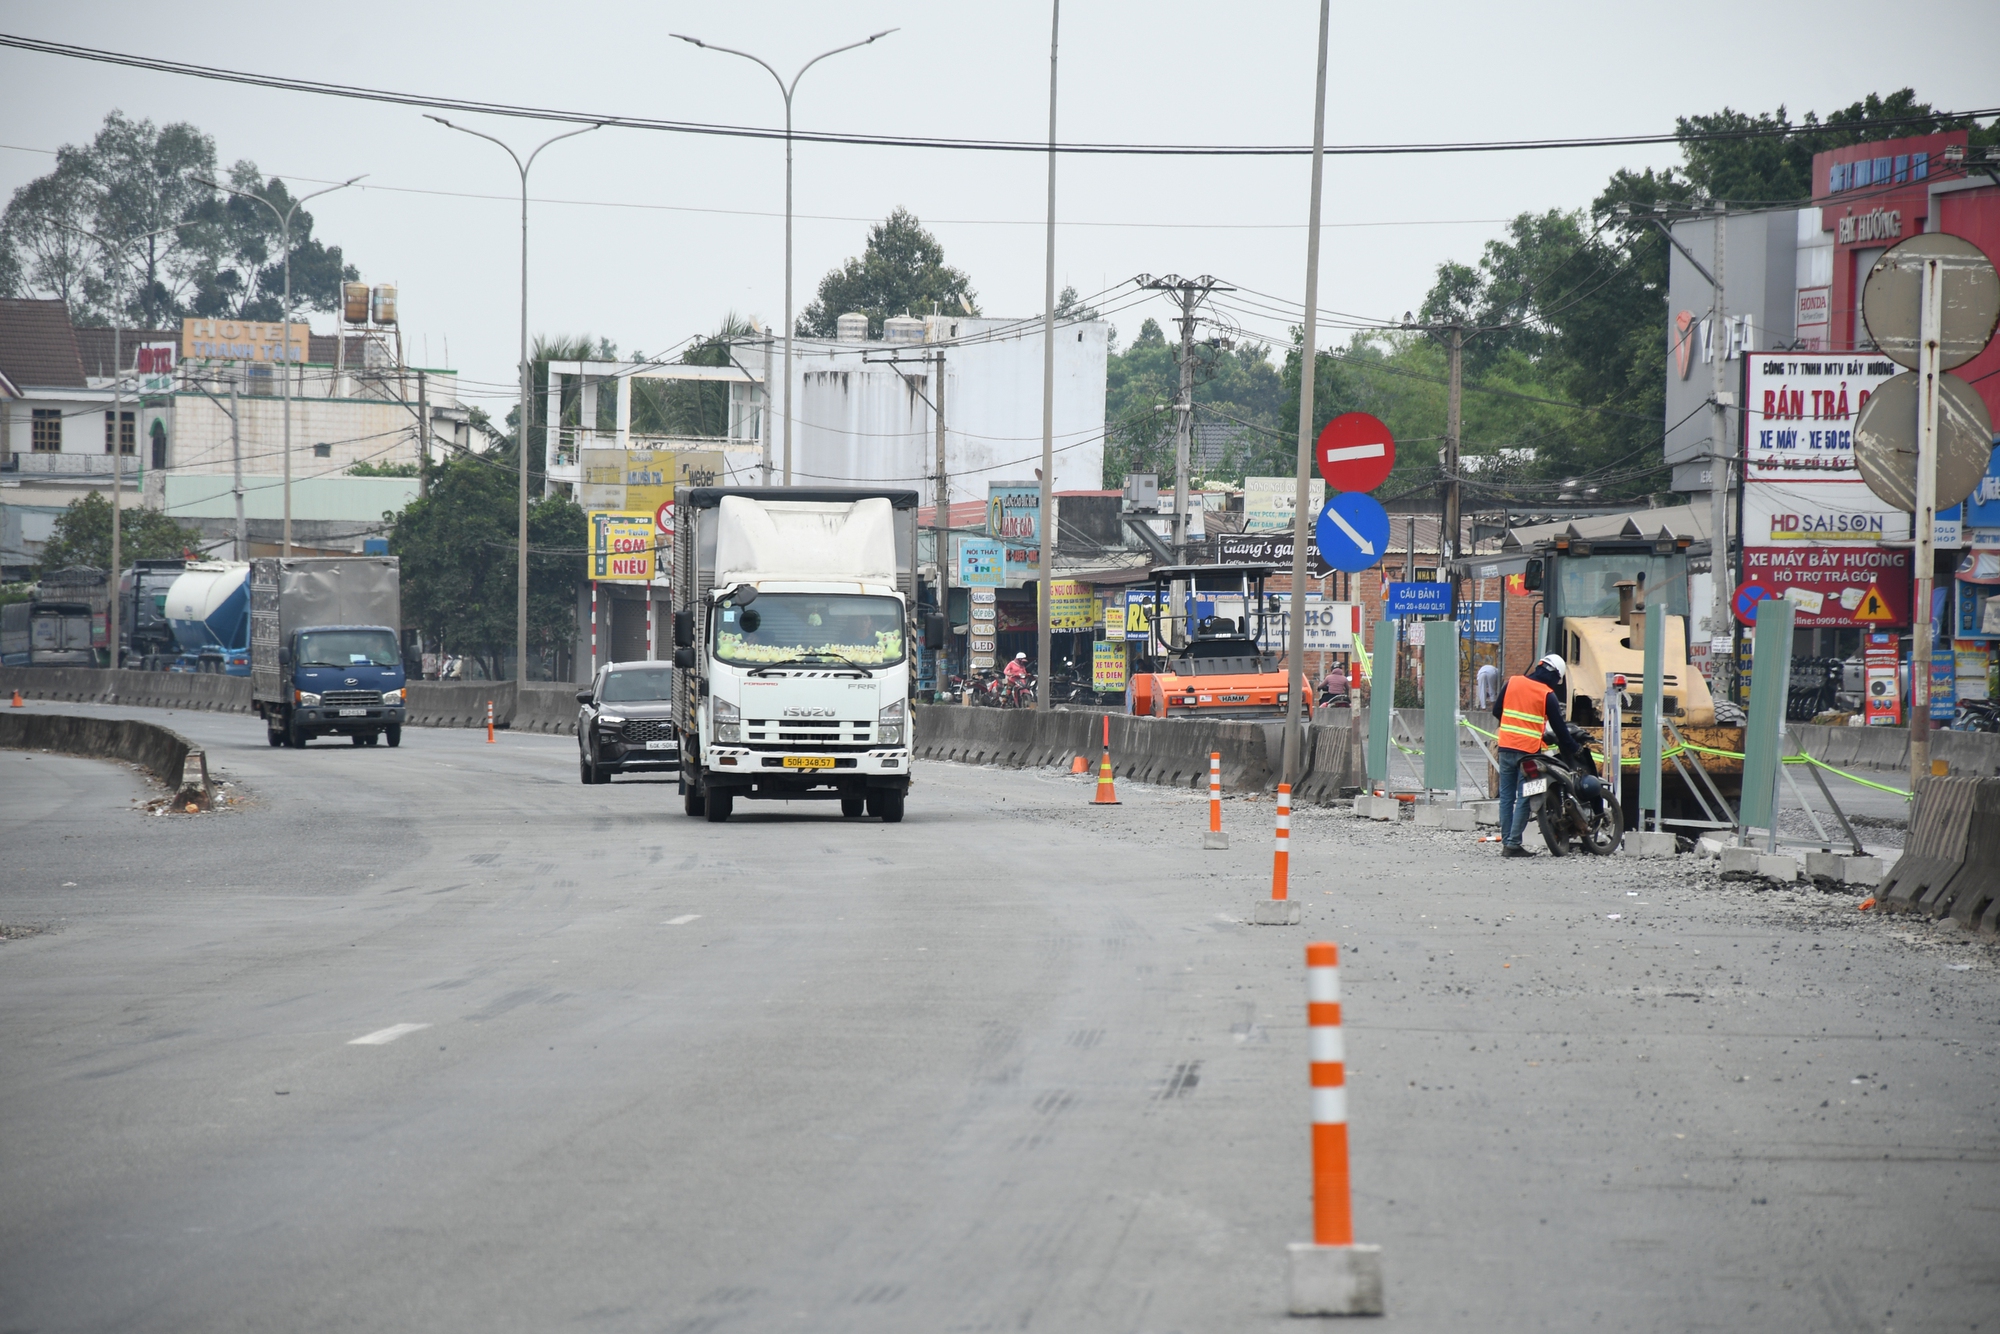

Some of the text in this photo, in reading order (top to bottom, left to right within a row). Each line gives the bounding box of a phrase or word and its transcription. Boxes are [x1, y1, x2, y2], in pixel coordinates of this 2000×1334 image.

[1800, 296, 1827, 311] HONDA
[193, 321, 302, 343] HOTEL
[192, 341, 254, 359] THANH
[1763, 360, 1785, 375] CÔNG
[1788, 362, 1798, 376] TY
[1801, 362, 1822, 376] TNHH
[1824, 362, 1844, 376] MTV
[1847, 359, 1864, 376] BẢY
[1763, 381, 1850, 421] BÁN TRẢ
[1760, 430, 1773, 450] XE
[1776, 427, 1798, 450] MÁY
[1809, 430, 1822, 450] XE
[689, 464, 716, 487] weber
[1802, 514, 1883, 532] SAISON
[1223, 539, 1272, 558] Giang's
[613, 556, 647, 575] NIÊU
[1749, 549, 1905, 567] XE MÁY BẢY HƯƠNG
[1774, 567, 1793, 582] HỖ
[1795, 570, 1823, 585] TRỢ
[1418, 587, 1435, 599] BẢN
[1436, 590, 1440, 599] 1
[974, 641, 994, 651] LED
[1104, 661, 1114, 669] TAY
[1096, 671, 1105, 679] XE
[783, 706, 836, 717] ISUZU
[787, 758, 831, 767] 50H-348.57
